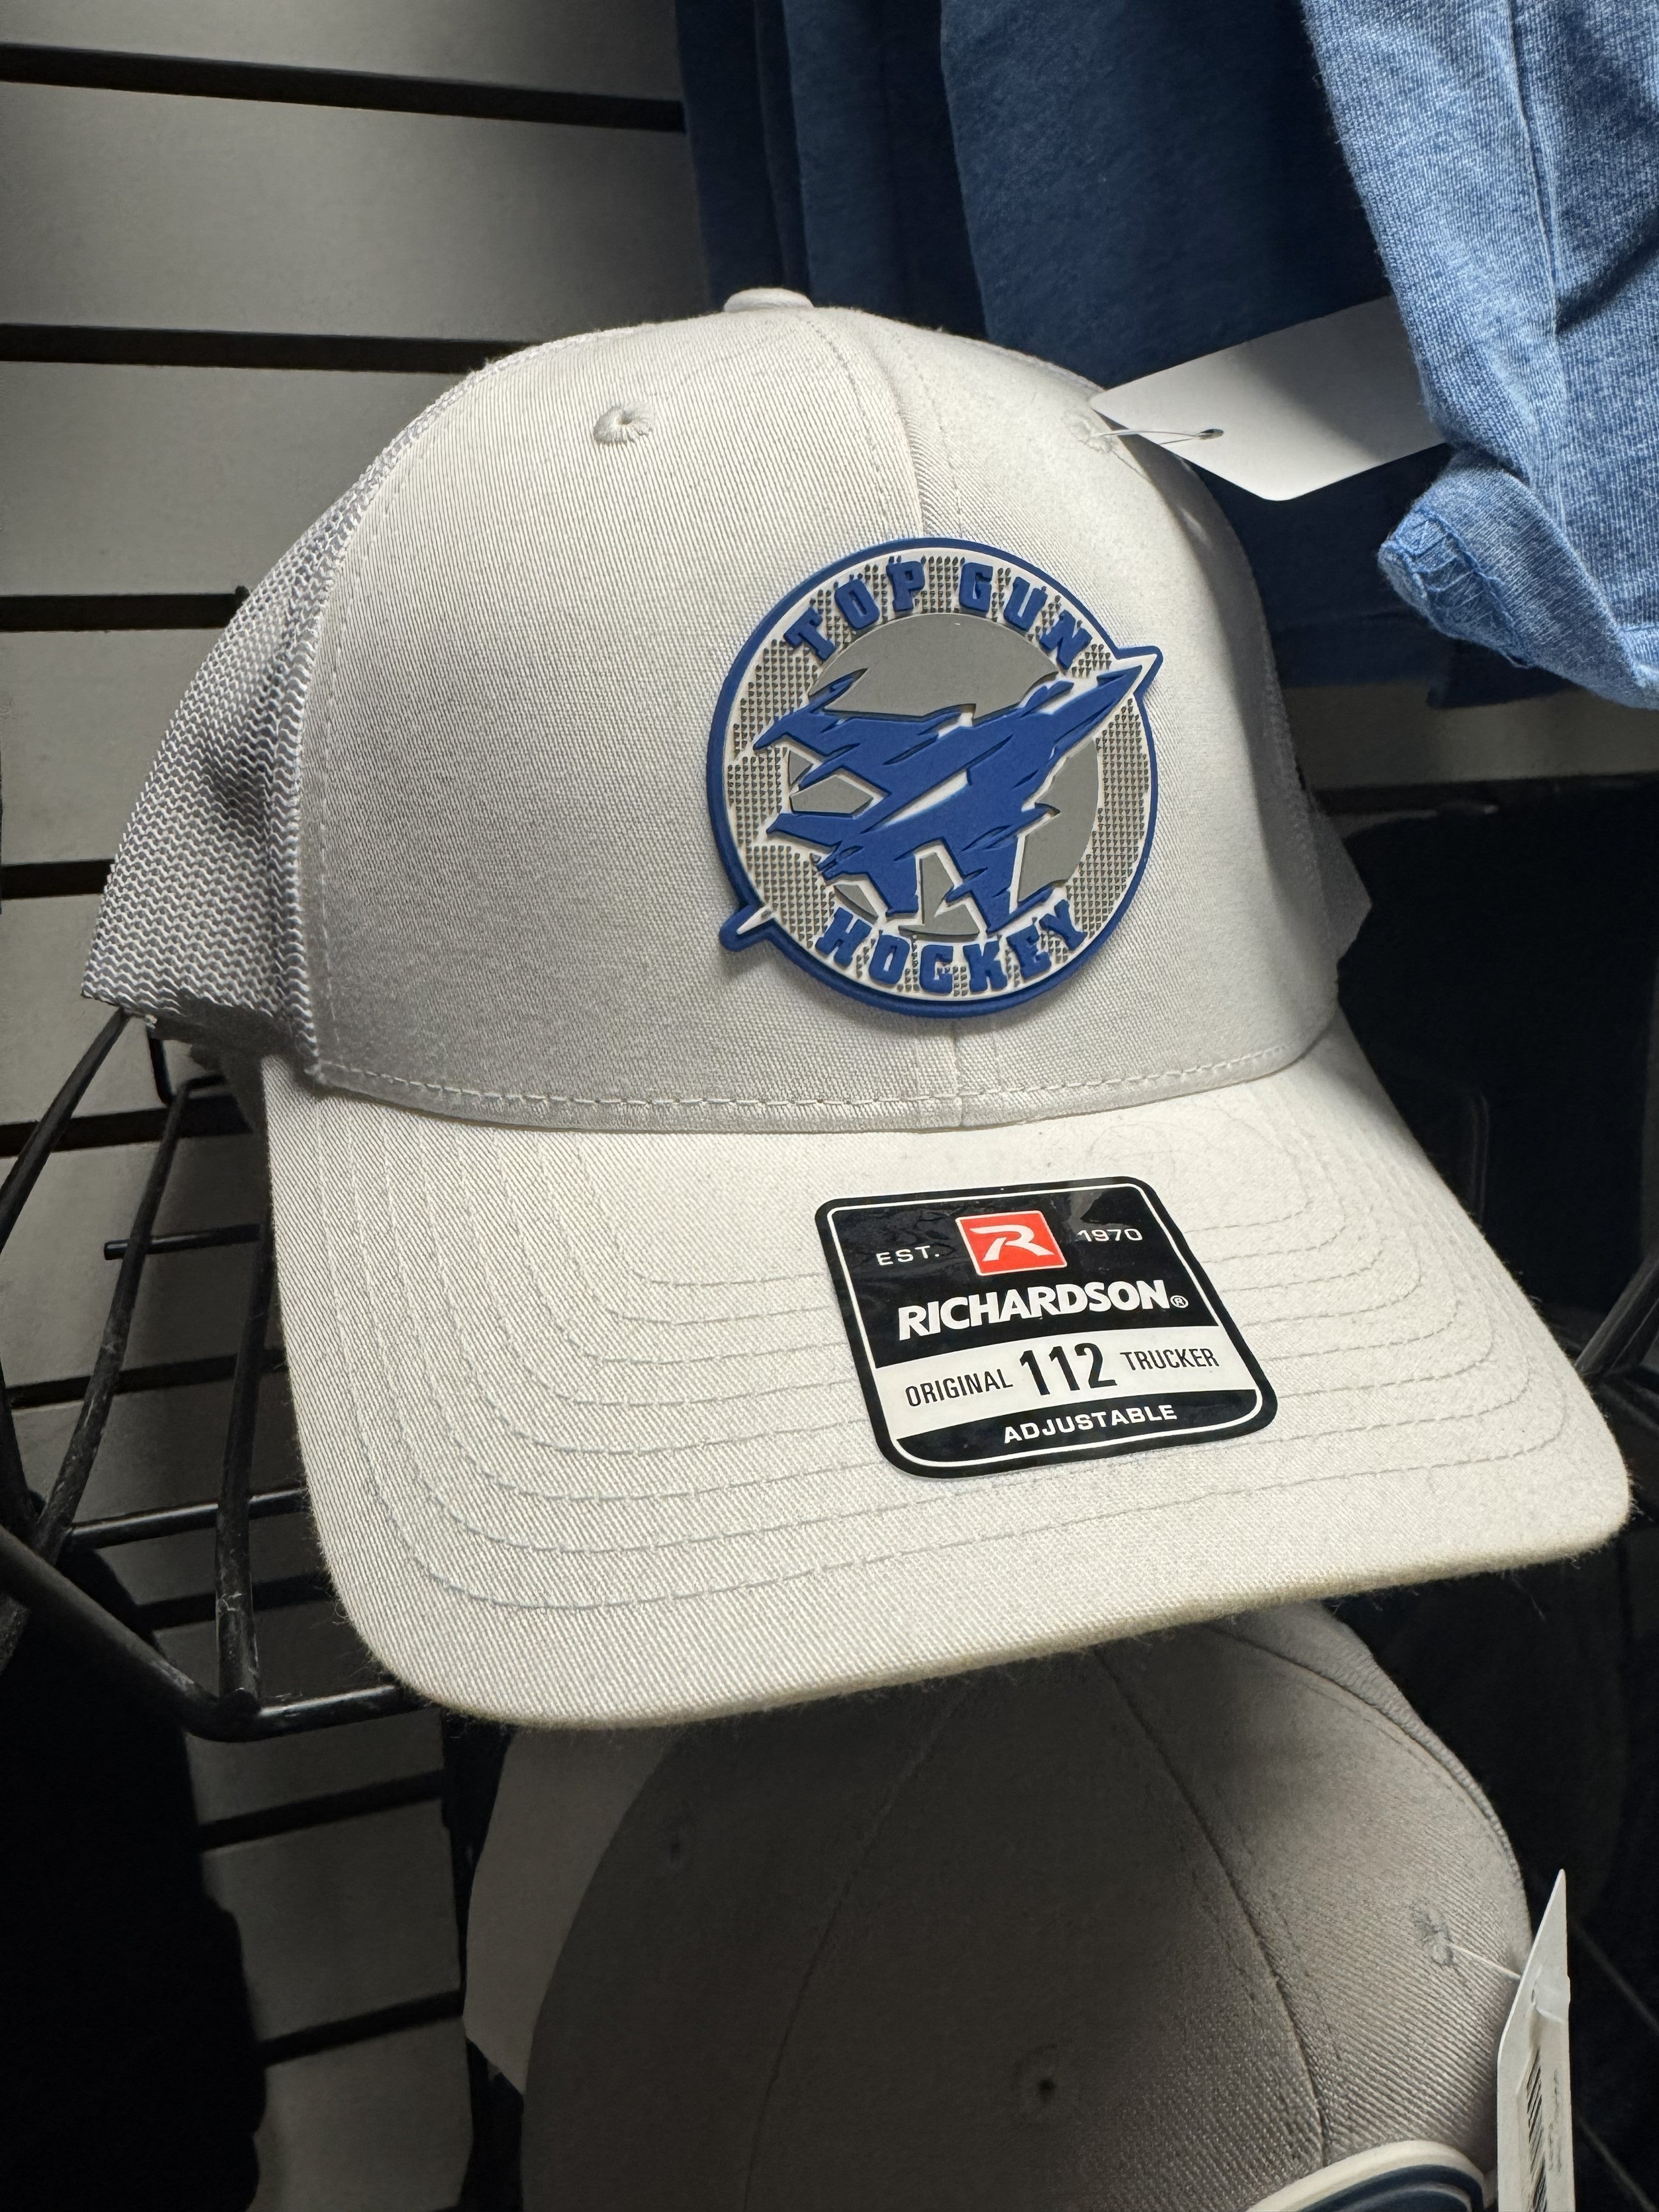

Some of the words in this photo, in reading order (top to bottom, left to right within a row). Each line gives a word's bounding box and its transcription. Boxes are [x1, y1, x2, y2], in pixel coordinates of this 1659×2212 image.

[785, 560, 926, 659] TOP
[959, 562, 1092, 667] GUN
[815, 899, 1086, 994] HOCKEY
[877, 1245, 940, 1266] EST.
[1077, 1228, 1143, 1242] 1970
[905, 1369, 1013, 1407] ORIGINAL
[1019, 1342, 1118, 1396] 112
[1120, 1348, 1220, 1372] TRUCKER
[1003, 1404, 1177, 1444] ADJUSTABLE
